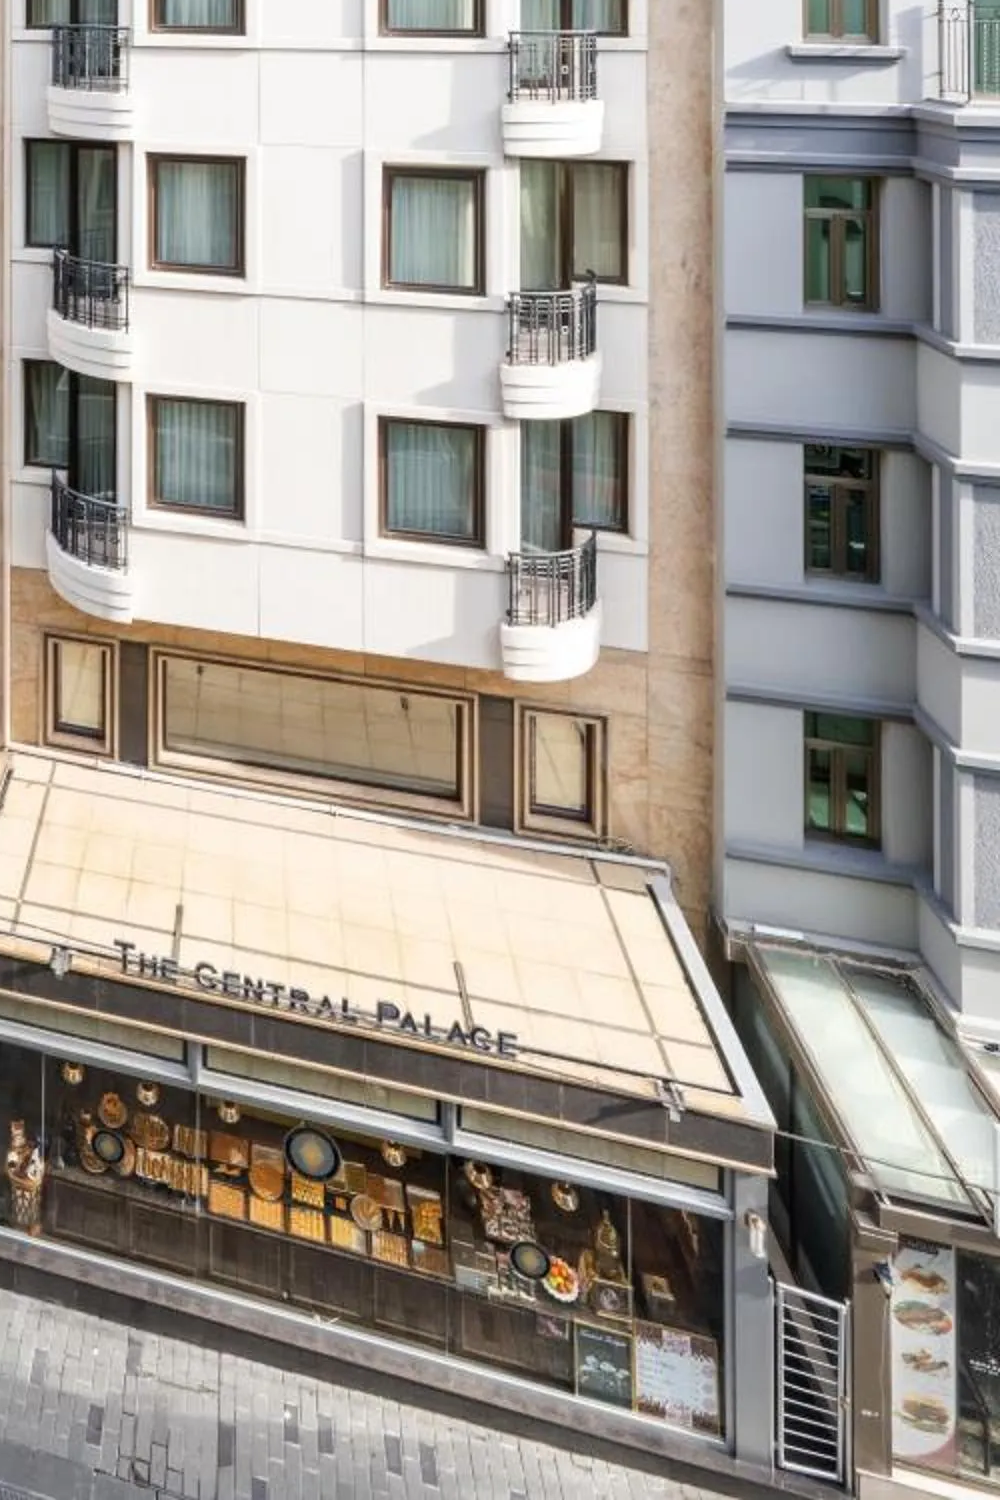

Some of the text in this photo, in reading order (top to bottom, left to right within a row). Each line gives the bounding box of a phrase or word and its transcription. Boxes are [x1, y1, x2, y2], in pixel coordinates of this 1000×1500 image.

[113, 938, 520, 1058] THE CENTRAL PALACE
